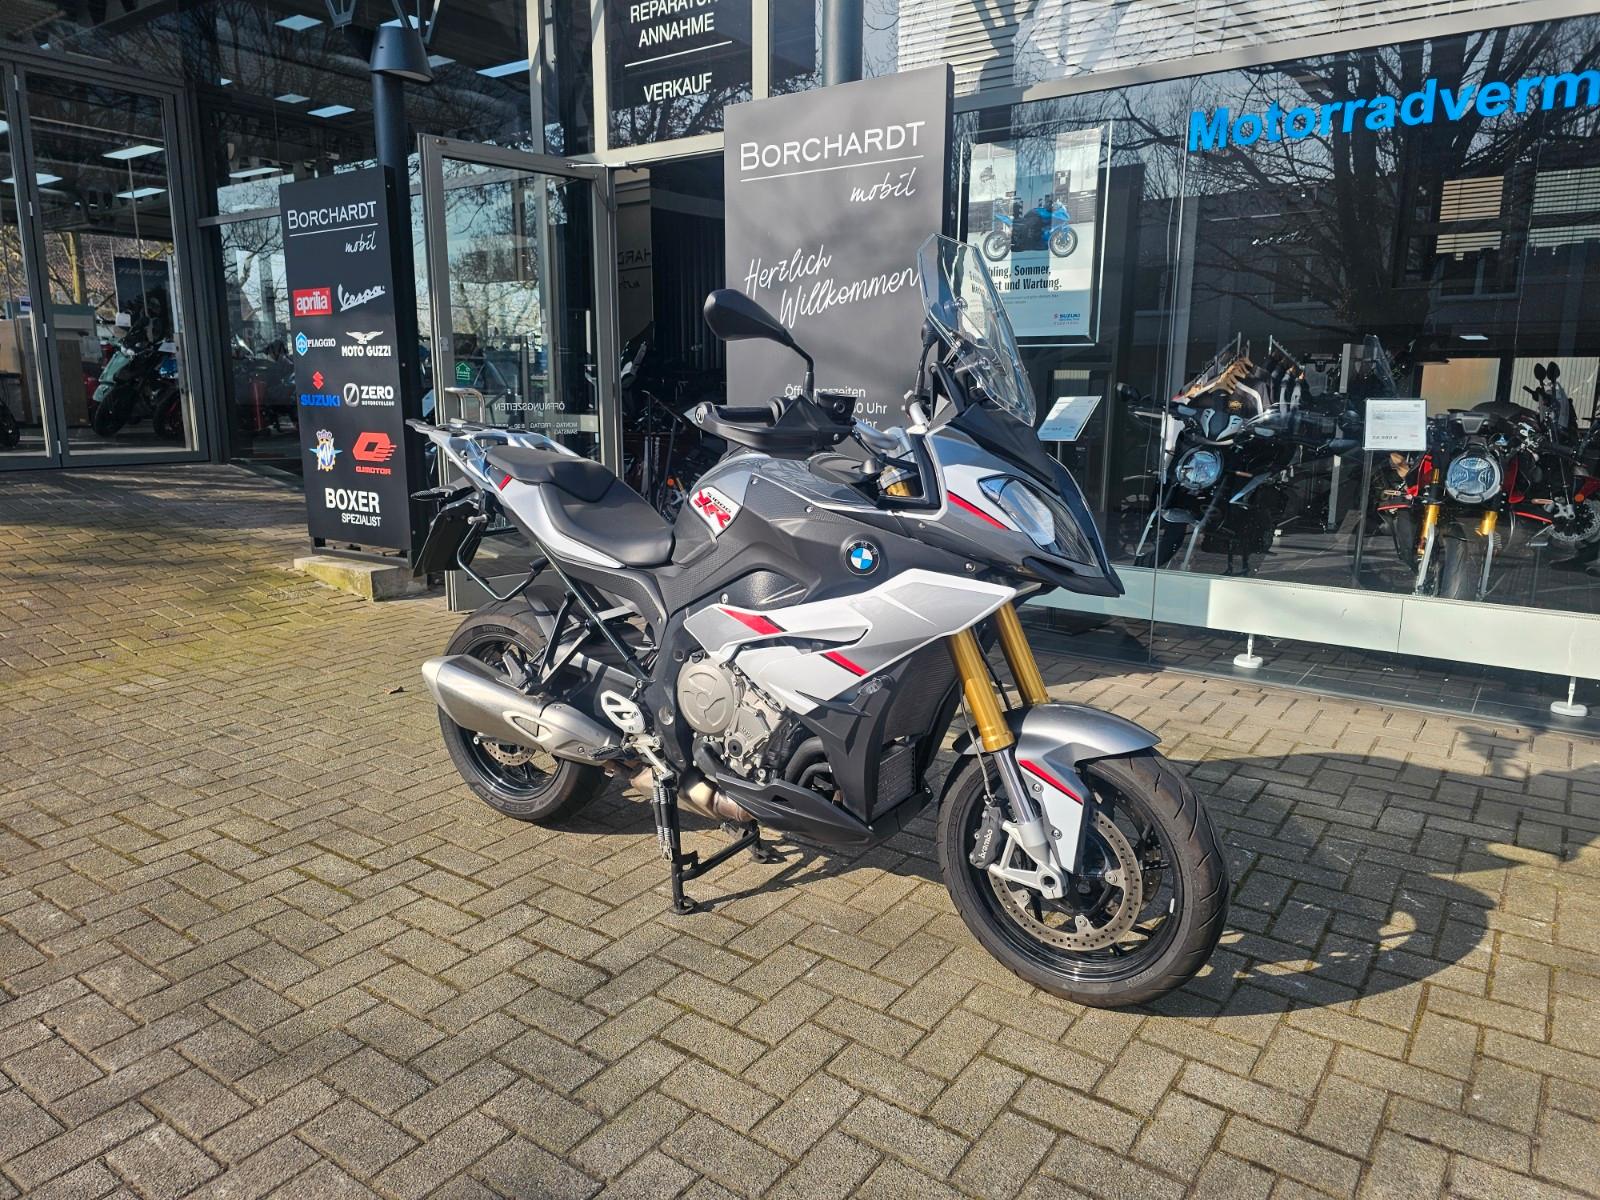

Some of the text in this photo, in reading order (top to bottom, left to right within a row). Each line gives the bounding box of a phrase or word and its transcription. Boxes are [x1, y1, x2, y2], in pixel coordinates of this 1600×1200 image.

[638, 12, 715, 48] ANNAHME
[643, 72, 713, 103] VERKAUF
[1188, 69, 1600, 152] Motorradverm
[850, 167, 917, 202] mobil
[345, 230, 377, 253] mobil
[744, 244, 832, 301] Herzlich
[1004, 280, 1020, 291] und
[1023, 277, 1062, 291] Wartung.
[1014, 264, 1051, 277] Sommer,
[296, 283, 385, 314] aprilia Vespa
[780, 266, 921, 329] Willkommen
[307, 338, 392, 357] PIAGGIO MOTO GUZZI
[300, 385, 394, 407] SUZUKI ZERO
[866, 402, 888, 415] Uhr
[324, 487, 381, 514] BOXER
[341, 512, 381, 527] SPEZIALIST
[978, 829, 993, 859] brembo
